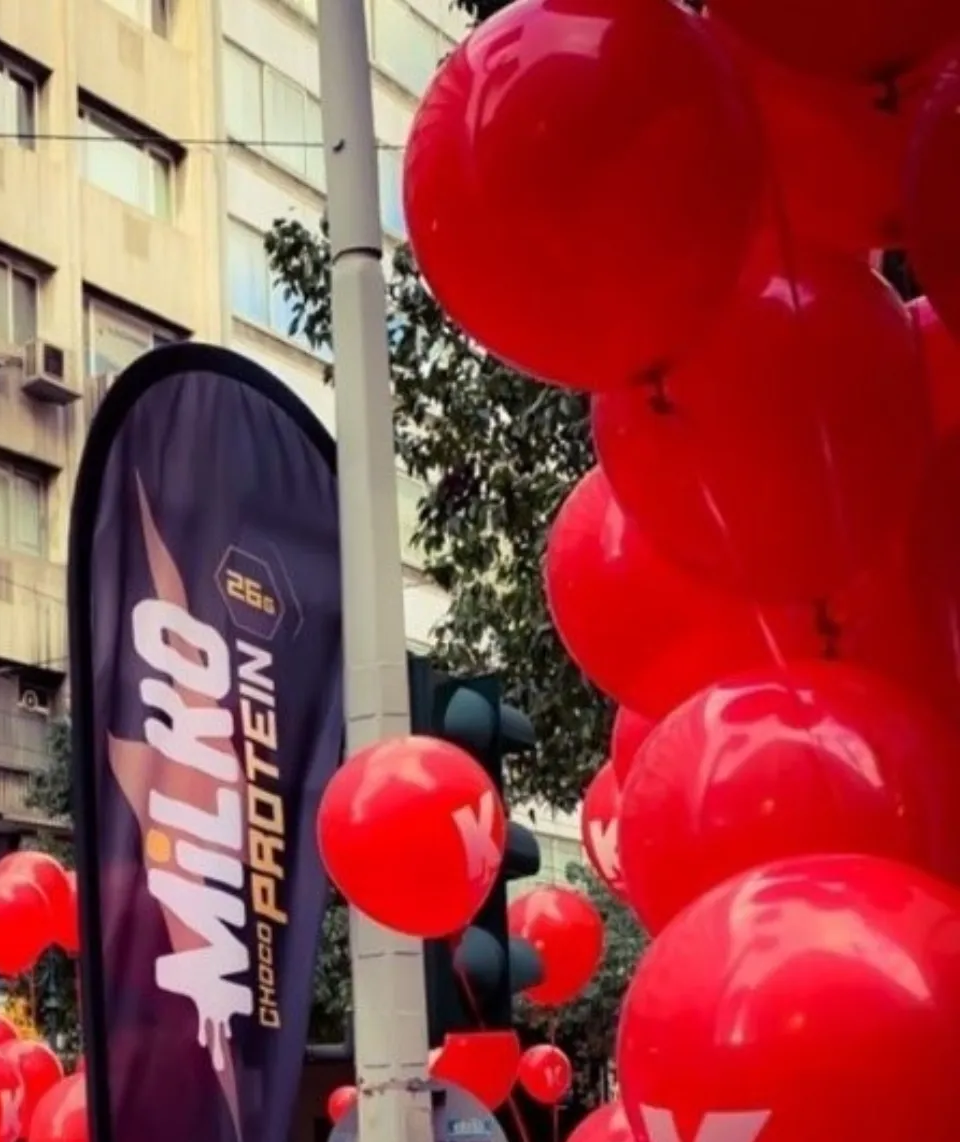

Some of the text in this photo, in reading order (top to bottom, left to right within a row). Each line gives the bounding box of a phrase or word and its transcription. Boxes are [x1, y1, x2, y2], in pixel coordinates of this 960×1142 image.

[236, 639, 288, 1029] CHOCO PROTEIN
[451, 789, 502, 886] K
